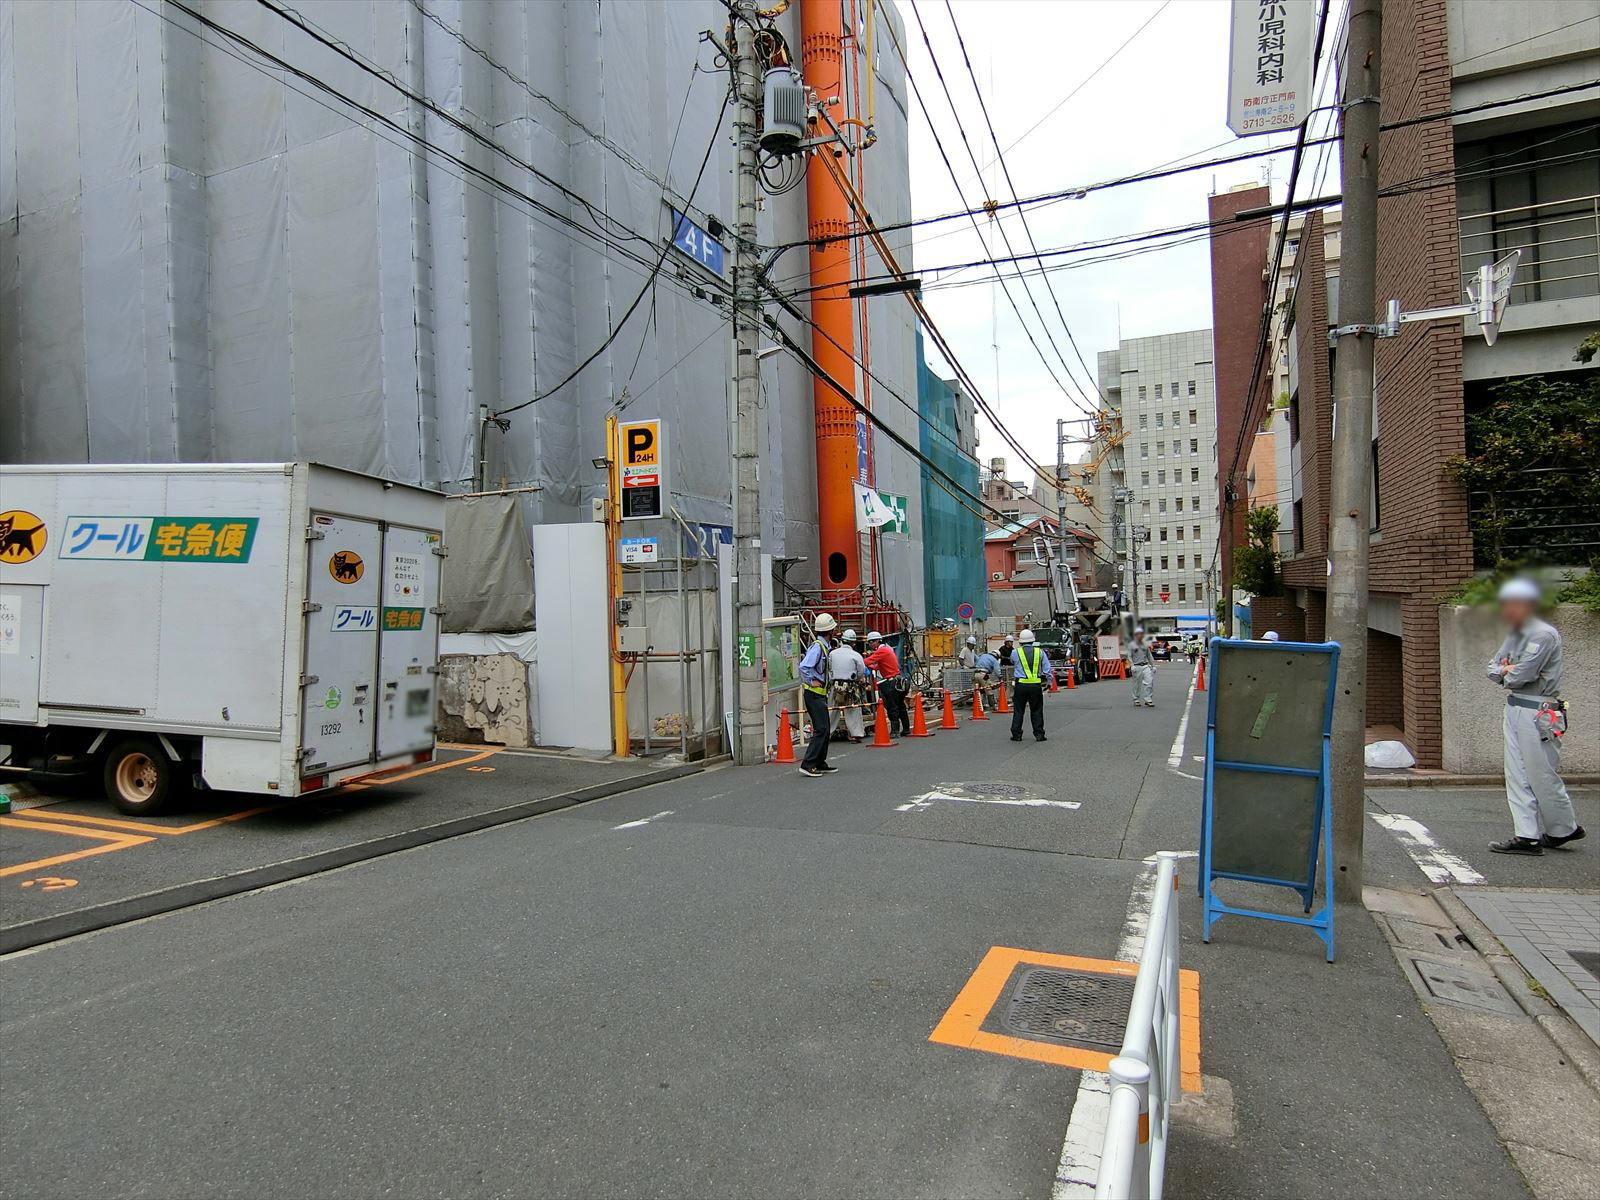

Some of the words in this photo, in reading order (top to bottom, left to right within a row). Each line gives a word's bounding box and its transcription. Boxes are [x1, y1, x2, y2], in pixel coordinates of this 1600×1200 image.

[1244, 92, 1296, 107] 防衛庁正門前
[1243, 113, 1295, 129] 3713-2526
[628, 427, 654, 464] P
[636, 453, 654, 463] 24H
[70, 522, 145, 555] クール
[155, 522, 247, 558] 宅急便
[336, 609, 374, 629] クール
[385, 610, 422, 629] 宅急便
[320, 722, 342, 736] 13292
